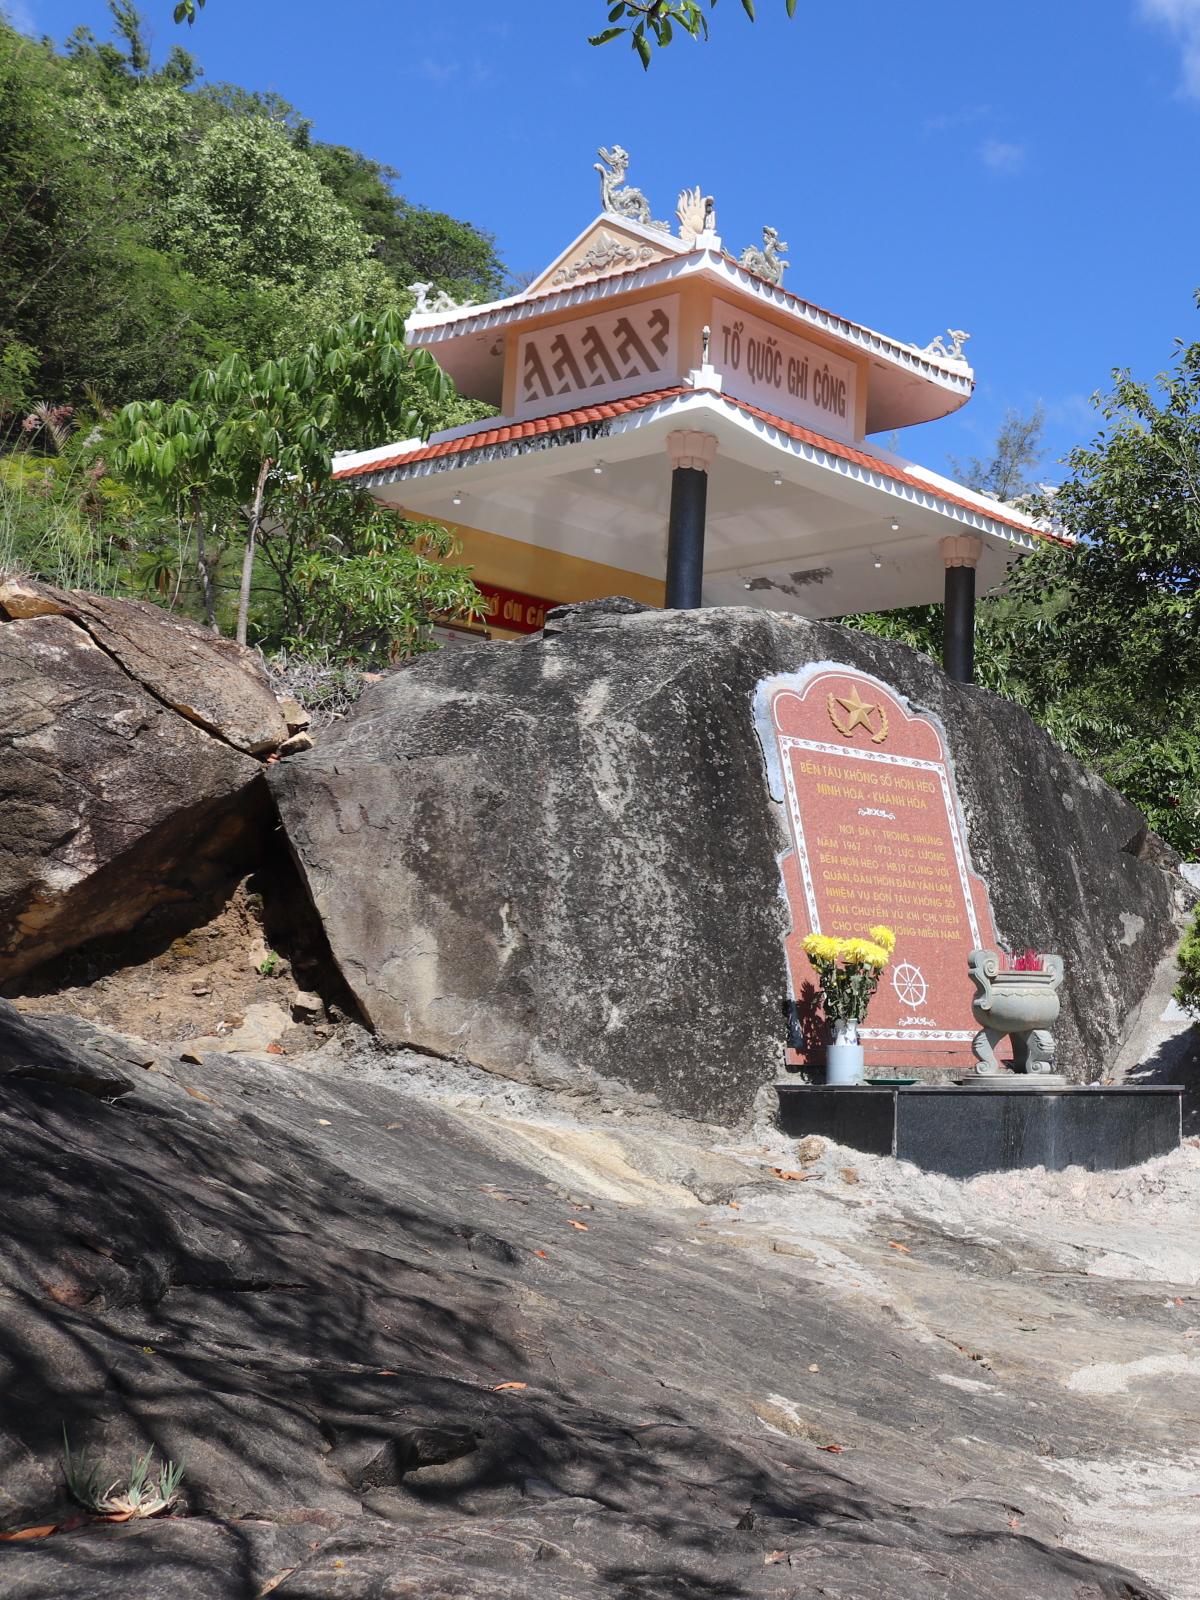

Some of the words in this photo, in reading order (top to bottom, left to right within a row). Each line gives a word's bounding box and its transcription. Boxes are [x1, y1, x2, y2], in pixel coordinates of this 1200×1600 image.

[722, 321, 744, 370] TỔ
[747, 337, 782, 389] QUỐC
[813, 363, 846, 418] CÔNG
[503, 599, 522, 622] ƠN
[526, 604, 547, 628] CÁ
[800, 759, 821, 776] BẾN
[822, 764, 841, 779] TÀU
[844, 768, 878, 785] KHÔNG
[880, 772, 893, 787] SỐ
[816, 783, 842, 797] NINH
[843, 785, 865, 800] HÒA
[872, 790, 905, 807] KHÁNH
[839, 825, 854, 835] NƠI
[882, 830, 910, 842] TRONG
[913, 833, 943, 846] NHỮNG
[820, 852, 838, 864] BẾN
[886, 862, 906, 873] HB19
[842, 840, 861, 851] 1967
[898, 847, 914, 860] LỰC
[918, 849, 946, 863] LƯỢNG
[853, 872, 873, 885] DÂN
[873, 873, 896, 887] THÔN
[825, 886, 855, 899] NHIỆM
[858, 890, 870, 901] VỤ
[873, 890, 892, 903] ĐÓN
[913, 895, 942, 908] KHÔNG
[945, 896, 956, 909] SỐ
[852, 903, 889, 918] CHUYỂN
[906, 909, 920, 921] KHÍ
[832, 920, 852, 931] CHO
[854, 920, 875, 933] CHIẾ
